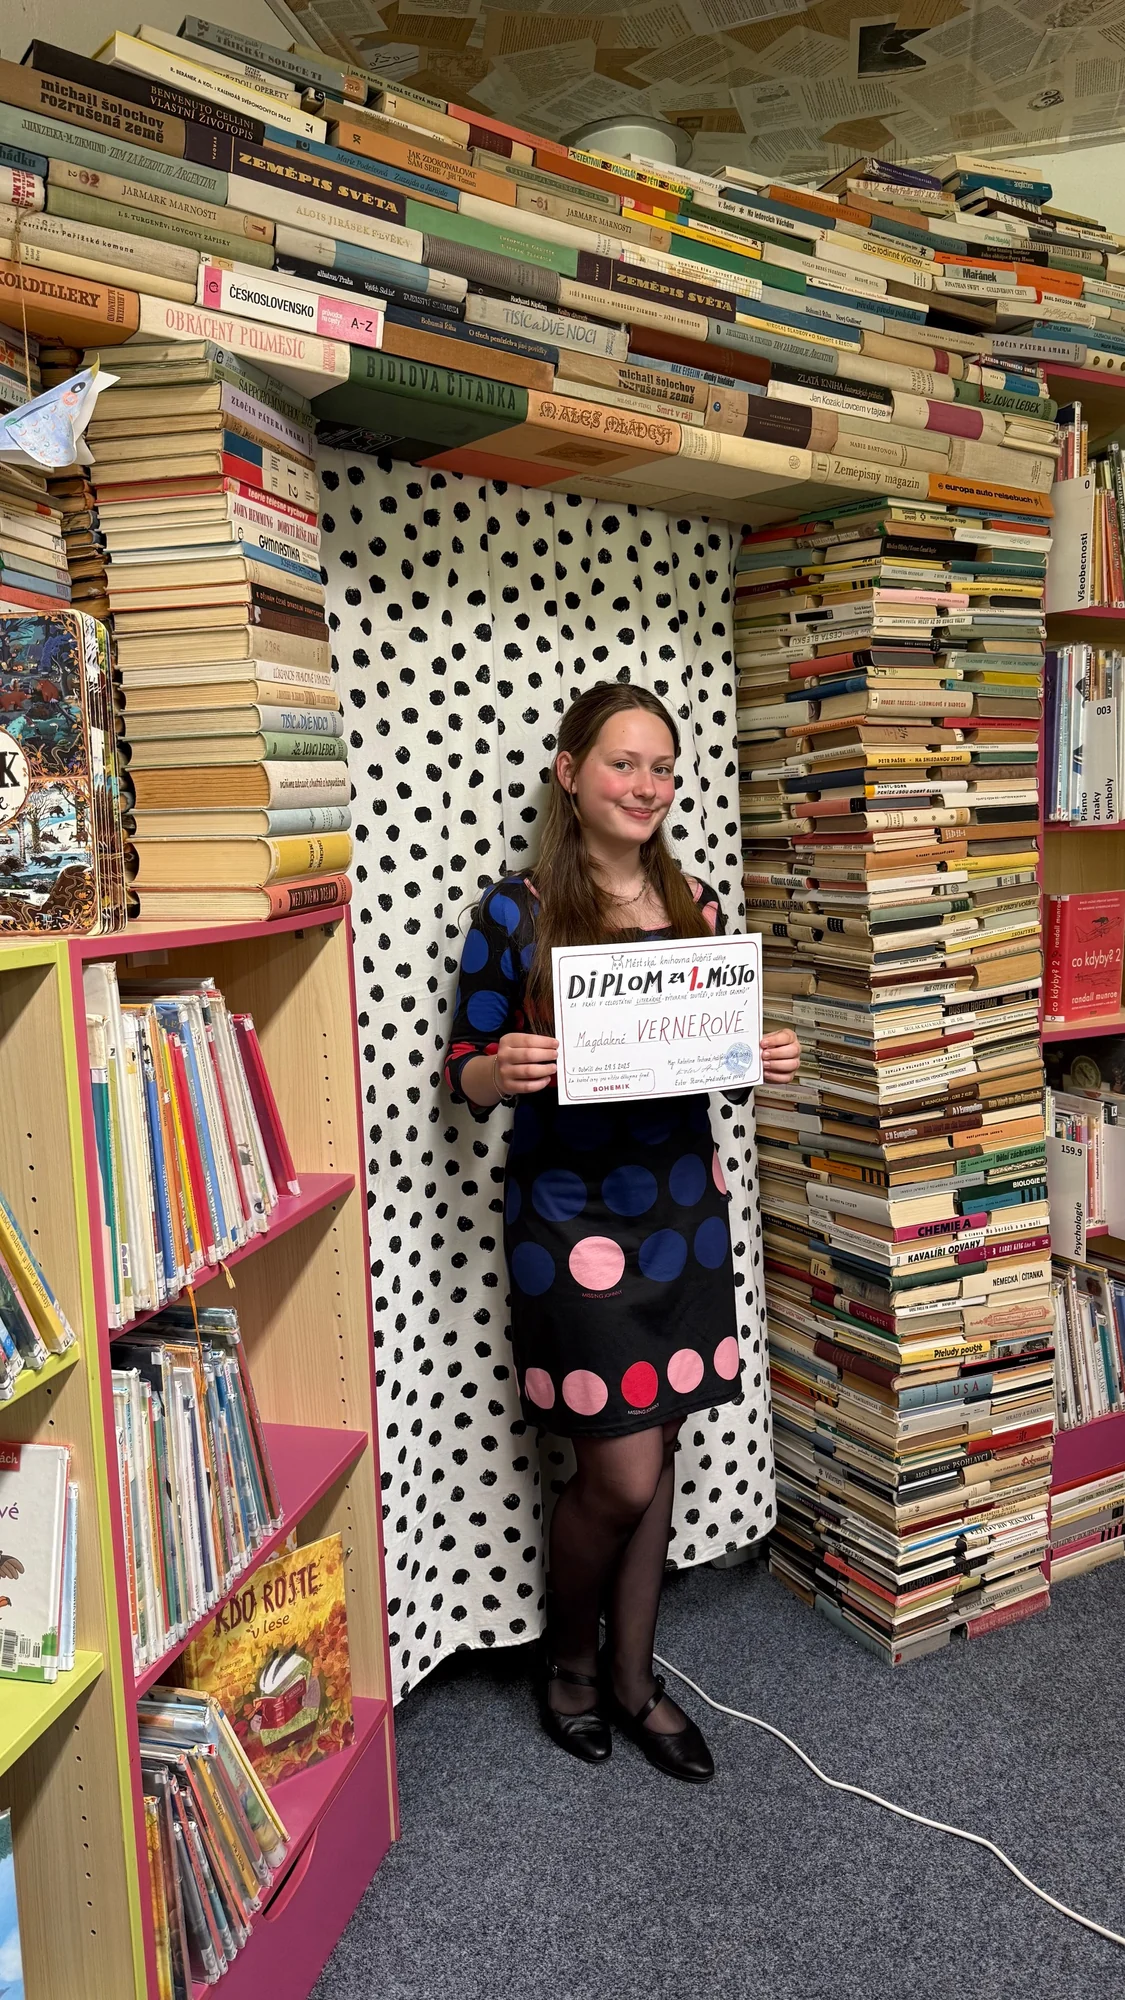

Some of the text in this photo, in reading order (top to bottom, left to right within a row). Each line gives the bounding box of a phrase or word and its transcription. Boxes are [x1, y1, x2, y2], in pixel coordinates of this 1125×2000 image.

[268, 53, 309, 75] SOUDCE
[41, 79, 164, 130] michail šolochov
[254, 83, 289, 100] OPERETY
[40, 92, 164, 143] rozrušená země
[150, 96, 254, 140] VLASTNÍ ŽIVOTOPIS
[151, 86, 254, 130] BENVENUTO CELLINI
[407, 149, 476, 179] JAK ZDOKONALOVAT
[424, 164, 441, 175] SEBE
[238, 152, 398, 214] ZEMĚPIS SVĚTA
[122, 185, 217, 220] JARMARK MARNOSTI
[566, 208, 632, 234] JARMARK MARNOSTI
[962, 268, 997, 282] Mařánek
[617, 273, 733, 312] ZEMĚPIS SVĚTA
[229, 284, 373, 333] ČESKOSLOVENSKO A-Z
[166, 308, 234, 343] OBRÁCENÝ
[240, 327, 305, 360] PŮLMĚSÍC
[502, 308, 532, 328] TISÍC
[542, 318, 565, 336] DVĚ
[568, 326, 597, 344] NOCI
[1019, 343, 1046, 352] PÁTERA
[1048, 346, 1070, 355] AMARA
[366, 355, 440, 394] BIDLOVA
[447, 371, 516, 410] ČÍTANKA
[618, 379, 694, 405] rozrušená země
[619, 368, 696, 394] michail šolochov
[797, 373, 844, 390] ZLATÁ KNIHA
[809, 393, 822, 404] Jan
[993, 393, 1041, 413] LOVCI LEBEK
[231, 395, 256, 417] ZLOČIN
[258, 409, 284, 432] PÁTERA
[285, 427, 305, 445] AMARA
[657, 404, 674, 416] Smrt
[681, 410, 693, 421] ráji
[834, 461, 920, 490] Zeměpisný magazin
[248, 487, 309, 522] teorie tělesné výchovy
[945, 482, 1033, 504] europa auto reisebuch
[233, 501, 248, 518] JOHN
[249, 507, 274, 529] HEMMING
[277, 519, 295, 536] DOBYTÍ
[258, 534, 300, 560] GYMNASTIKA
[1078, 532, 1088, 603] Všeobecnosti
[1096, 706, 1112, 716] 003
[319, 742, 336, 756] LEBEK
[1093, 791, 1101, 821] Znaky
[1105, 778, 1114, 820] Symboly
[290, 890, 303, 907] MEZI
[303, 886, 319, 904] DVĚMA
[660, 955, 690, 965] knihovna
[1072, 948, 1121, 969] co kdyby? 2
[687, 966, 704, 991] 1.
[1052, 969, 1062, 1000] kdyby?
[949, 998, 998, 1015] DUSTIN HOFFMAN
[1052, 1002, 1058, 1012] co
[1072, 990, 1118, 1004] randall munroe
[637, 1000, 749, 1045] VERNEROVÉ
[593, 1084, 630, 1092] BOHEMIK
[1061, 1144, 1082, 1157] 159.9
[1013, 1177, 1040, 1189] BIOLOGIE
[918, 1219, 971, 1237] CHEMIE A
[1074, 1201, 1082, 1257] Psychologie
[907, 1239, 981, 1263] KAVALÍŘI ODVAHY
[992, 1269, 1043, 1287] NĚMECKÁ ČÍTANKA
[934, 1343, 983, 1358] Přeludy pouště
[915, 1470, 929, 1479] ALOIS
[952, 1452, 988, 1469] PSOHLAVCI
[213, 1584, 256, 1638] KDO
[252, 1613, 291, 1640] v lese
